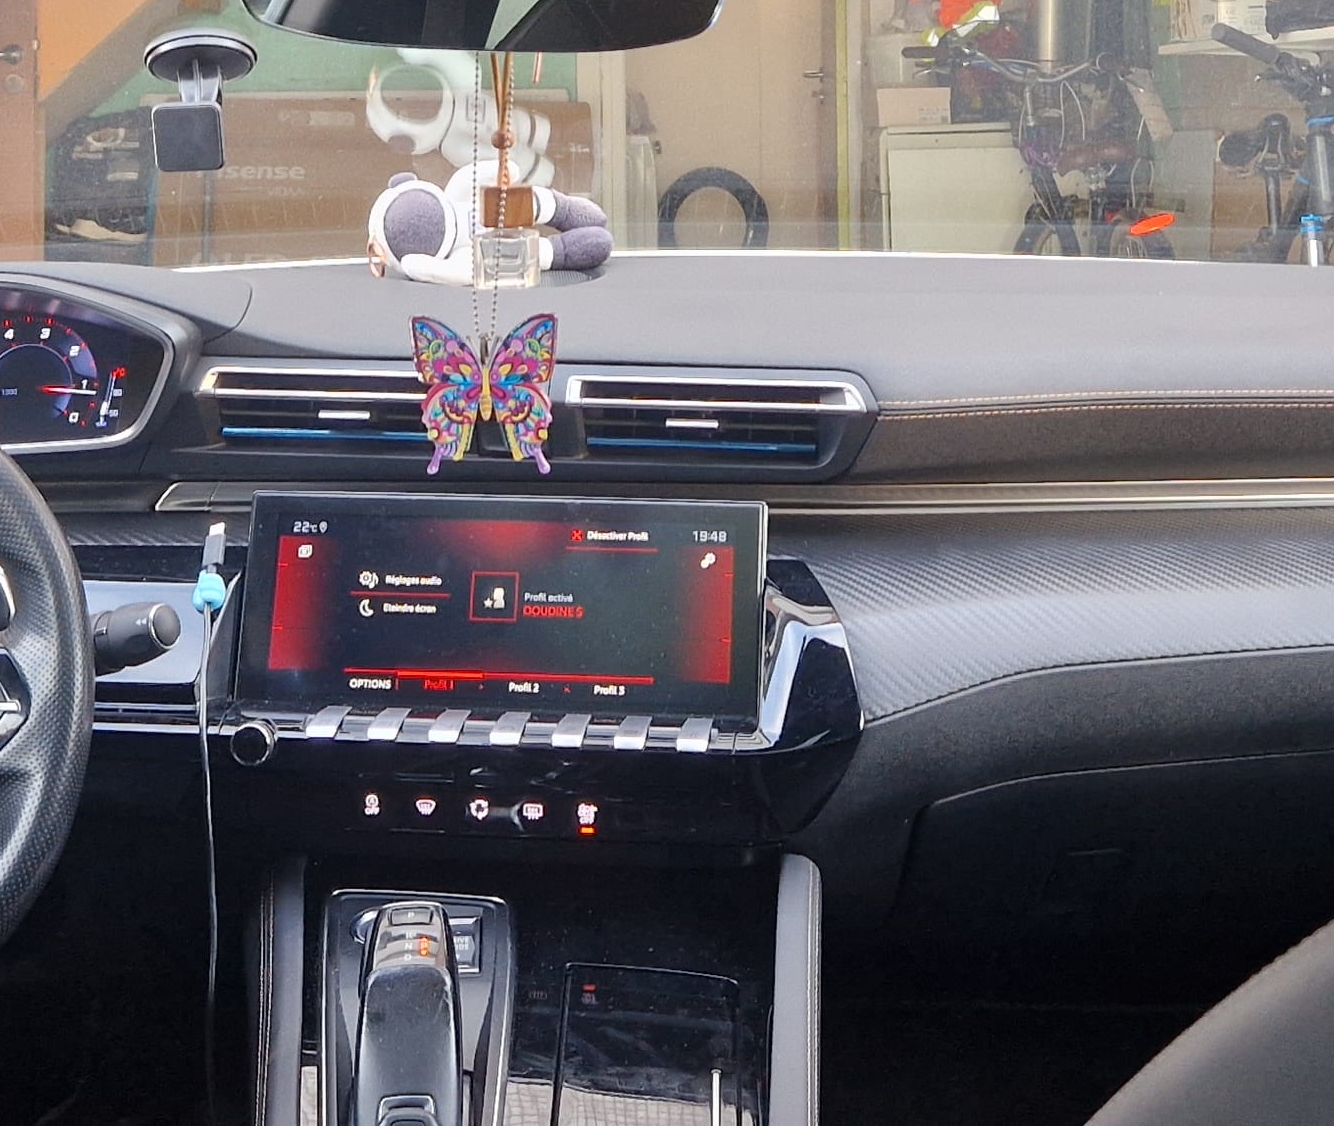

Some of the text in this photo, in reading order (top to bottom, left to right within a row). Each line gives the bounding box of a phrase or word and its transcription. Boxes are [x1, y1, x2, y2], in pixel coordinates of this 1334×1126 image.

[5, 329, 15, 340] 4
[41, 328, 52, 339] 3
[70, 345, 80, 356] 2
[70, 413, 80, 424] 0
[628, 531, 649, 542] Profil
[420, 576, 443, 586] audio
[524, 592, 573, 603] Profil activé
[349, 678, 391, 690] OPTIONS
[508, 682, 531, 693] Profil
[532, 683, 540, 693] 2
[593, 684, 617, 696] Profil
